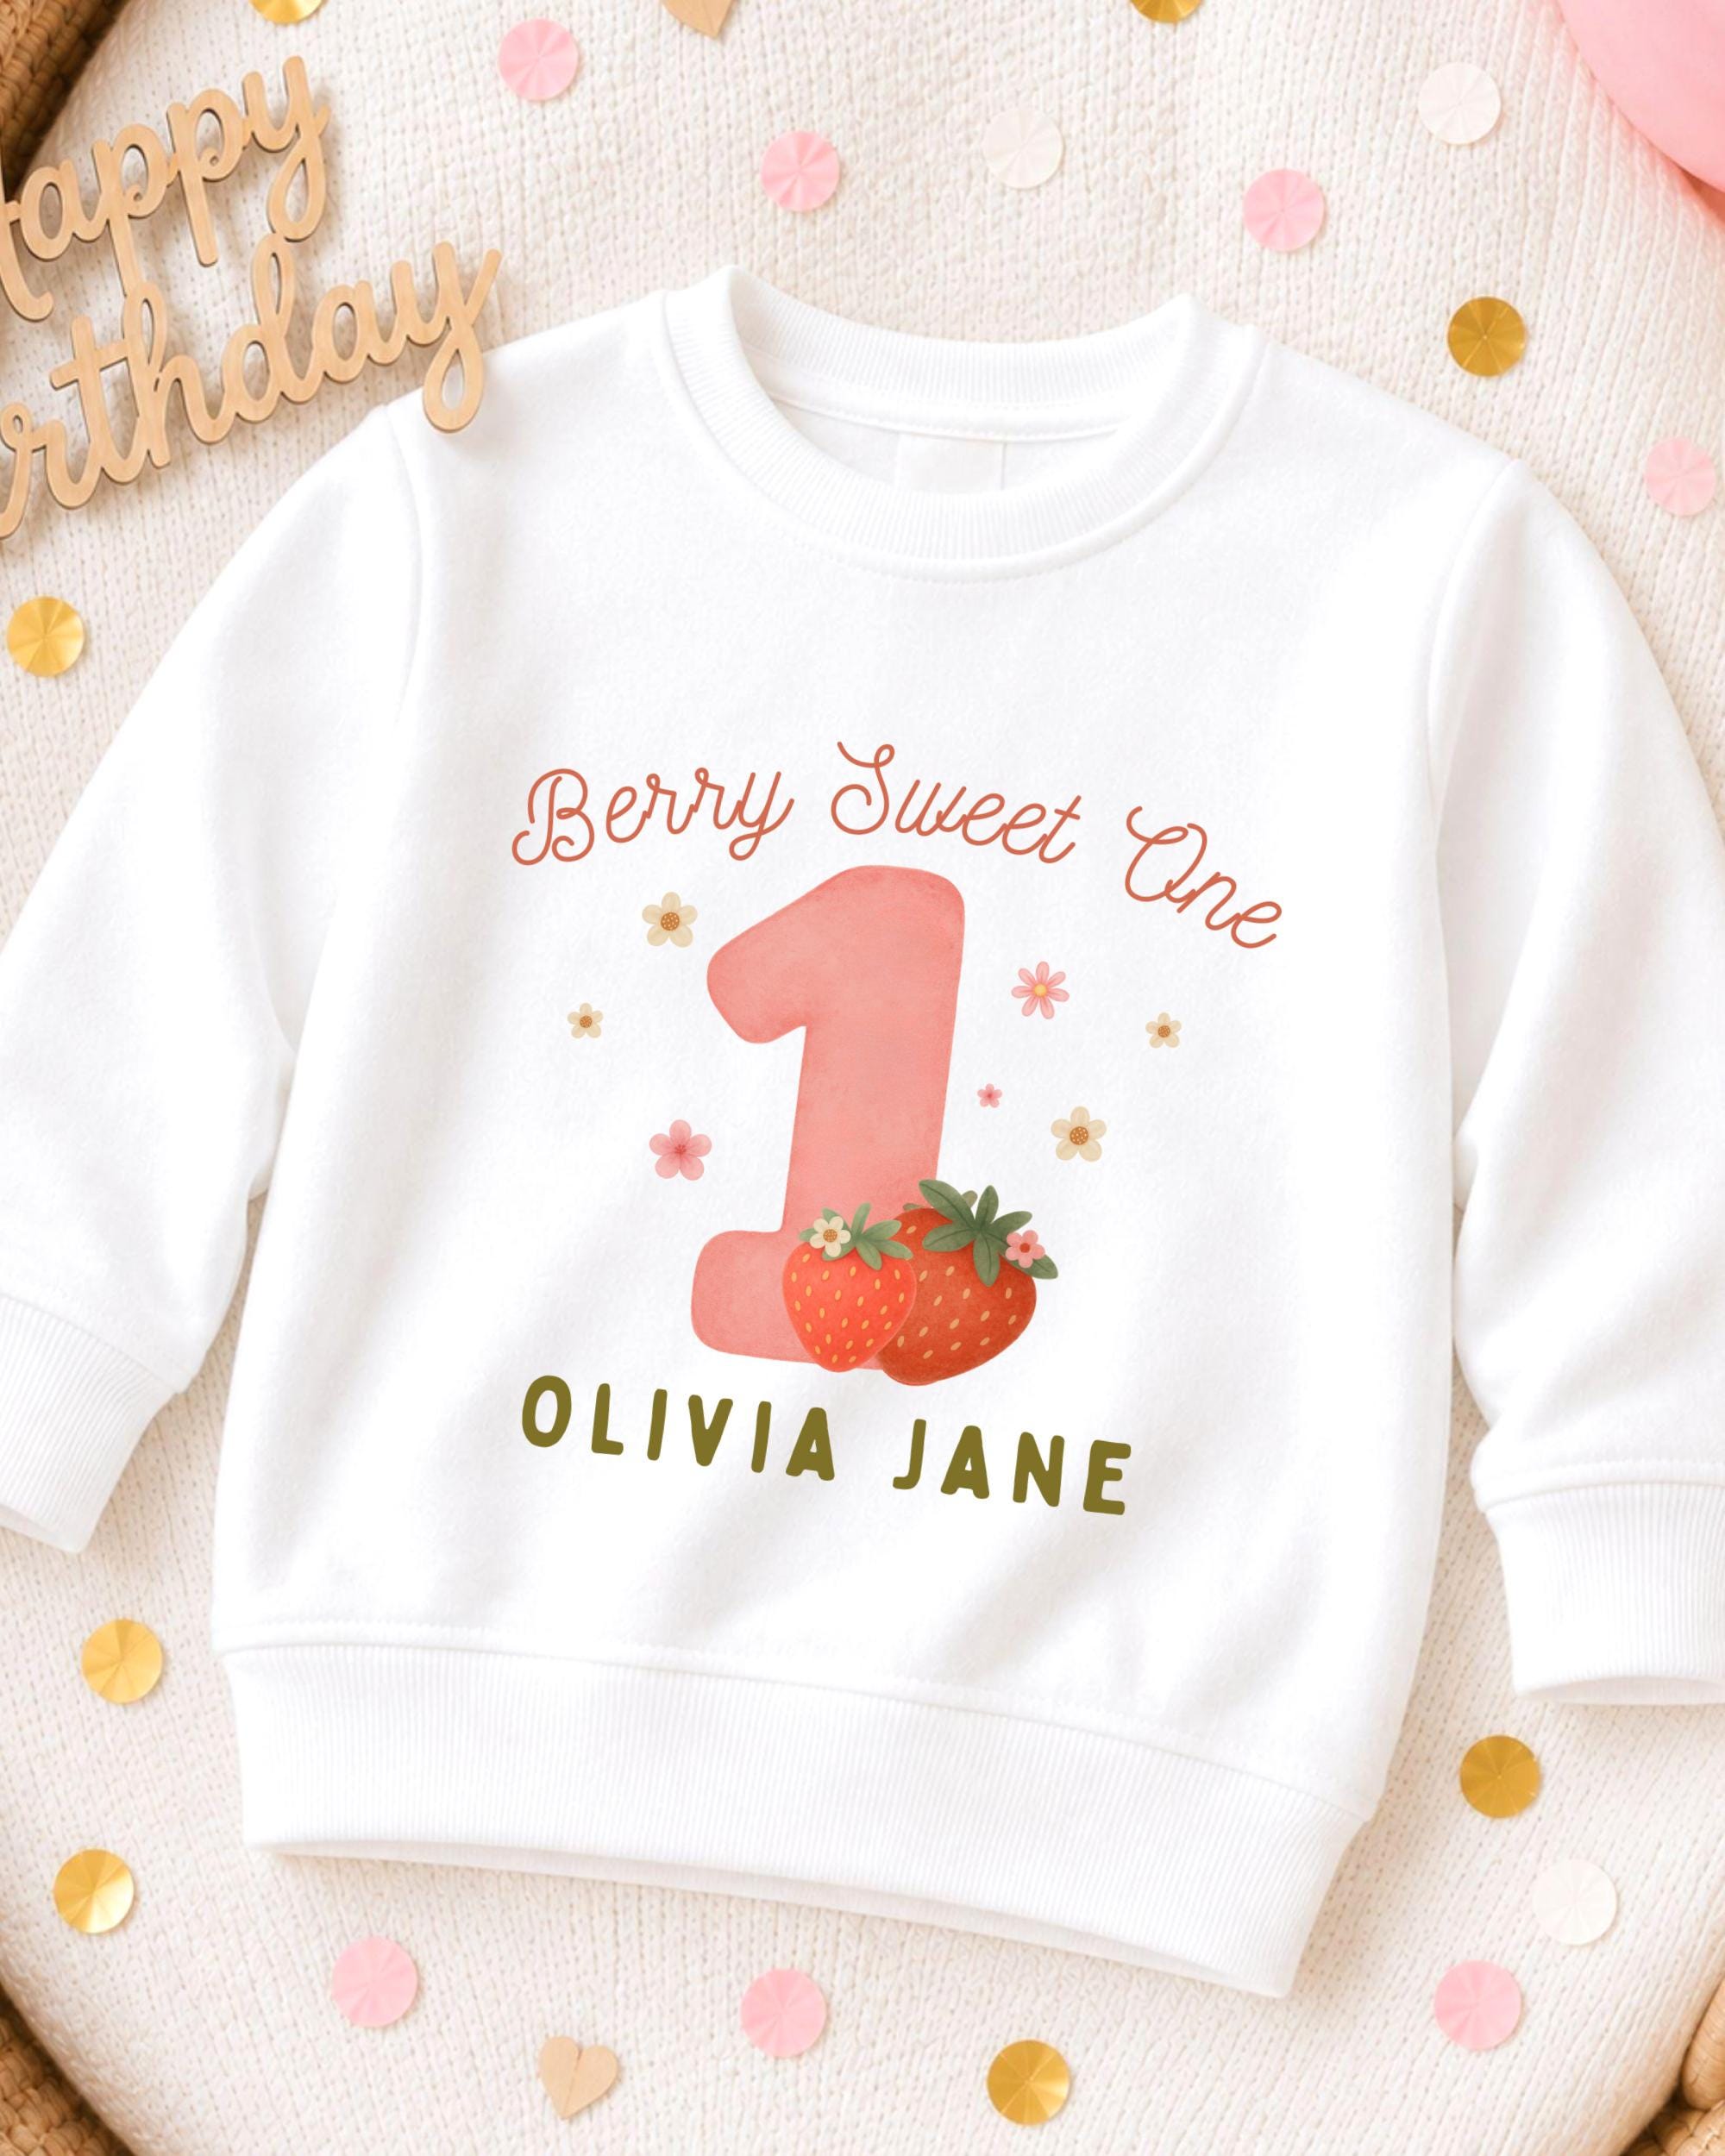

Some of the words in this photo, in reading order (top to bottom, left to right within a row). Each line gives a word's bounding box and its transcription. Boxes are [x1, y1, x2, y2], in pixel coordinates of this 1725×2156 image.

[511, 767, 794, 866] Berry
[831, 742, 1081, 863] Sweet
[1125, 806, 1283, 949] One
[691, 865, 966, 1373] 1
[522, 1375, 835, 1482] OLIVIA
[893, 1419, 1132, 1515] JANE
